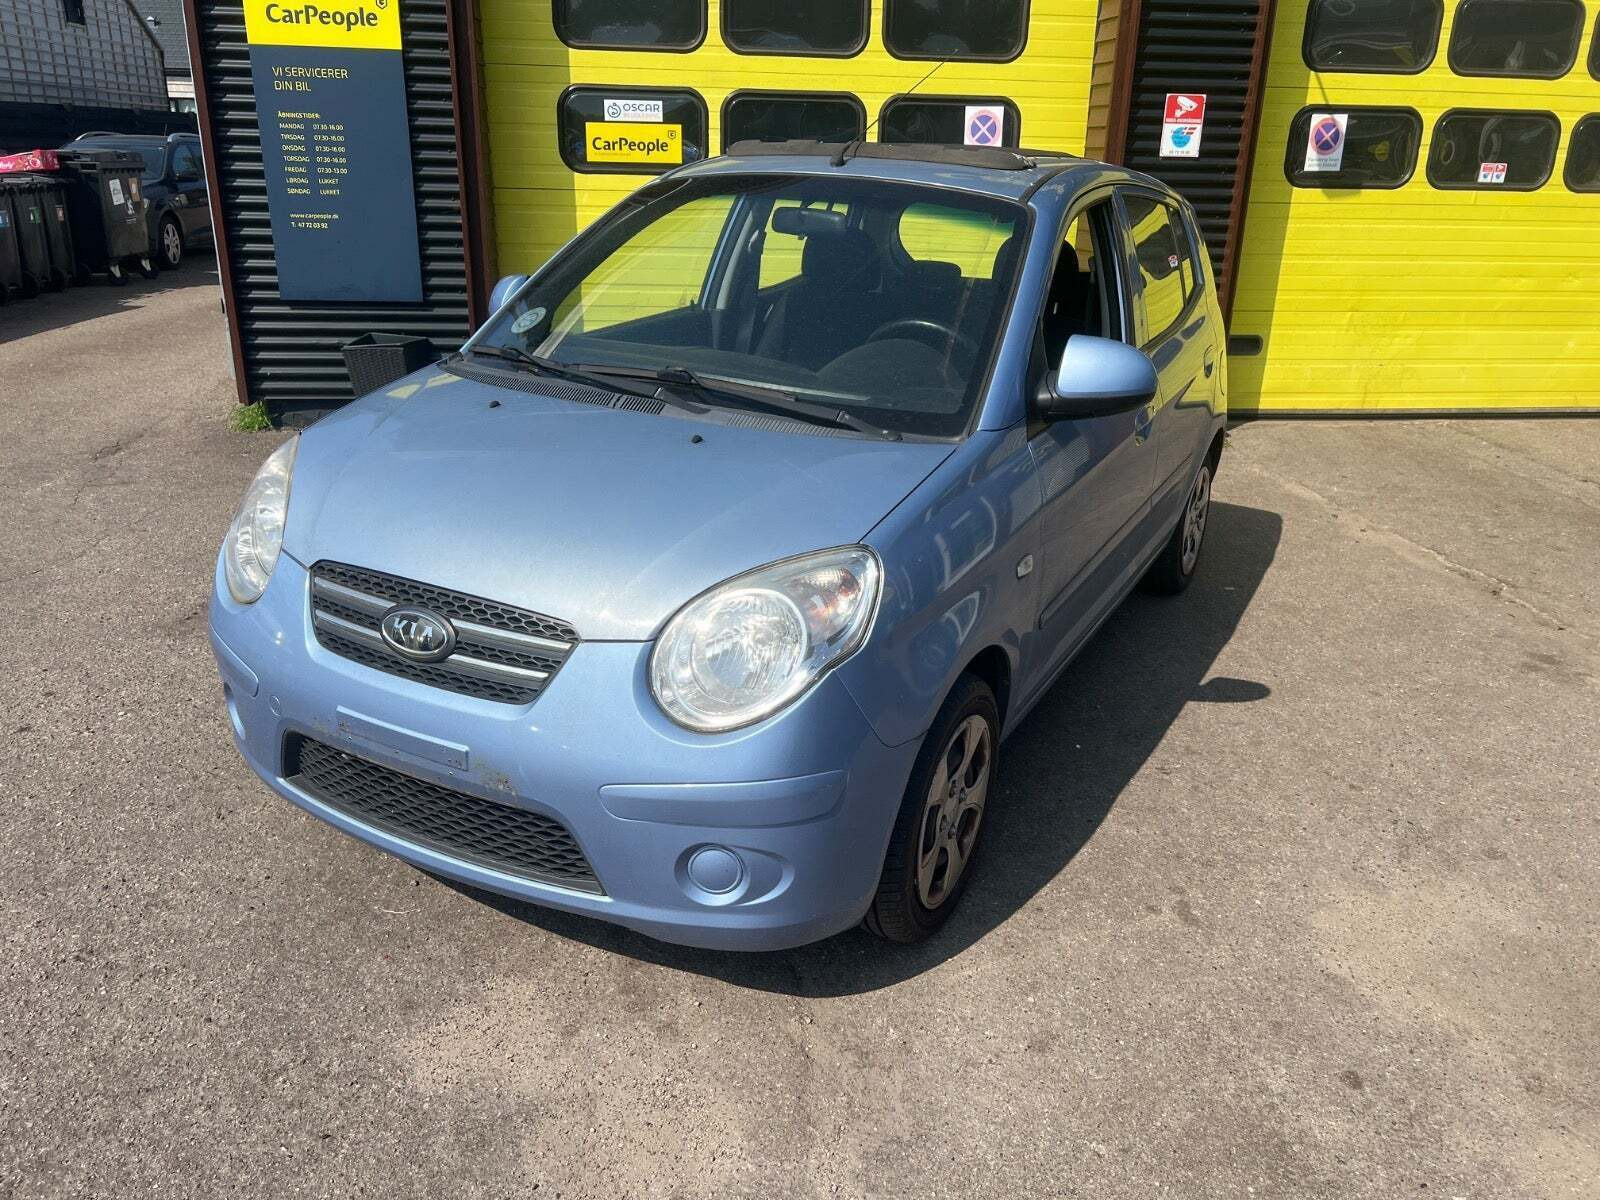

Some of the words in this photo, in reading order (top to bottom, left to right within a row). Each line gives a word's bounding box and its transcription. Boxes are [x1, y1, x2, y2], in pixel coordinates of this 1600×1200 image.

[265, 3, 378, 31] CarPeople
[271, 66, 283, 77] VI
[284, 66, 349, 79] SERVICERER
[274, 80, 293, 91] DIN
[295, 81, 312, 92] BIL
[622, 103, 660, 113] OSCAR
[279, 122, 305, 130] MANDAG
[281, 144, 306, 152] ONSDAG
[591, 136, 669, 156] CarPeople
[391, 616, 433, 652] KIA
